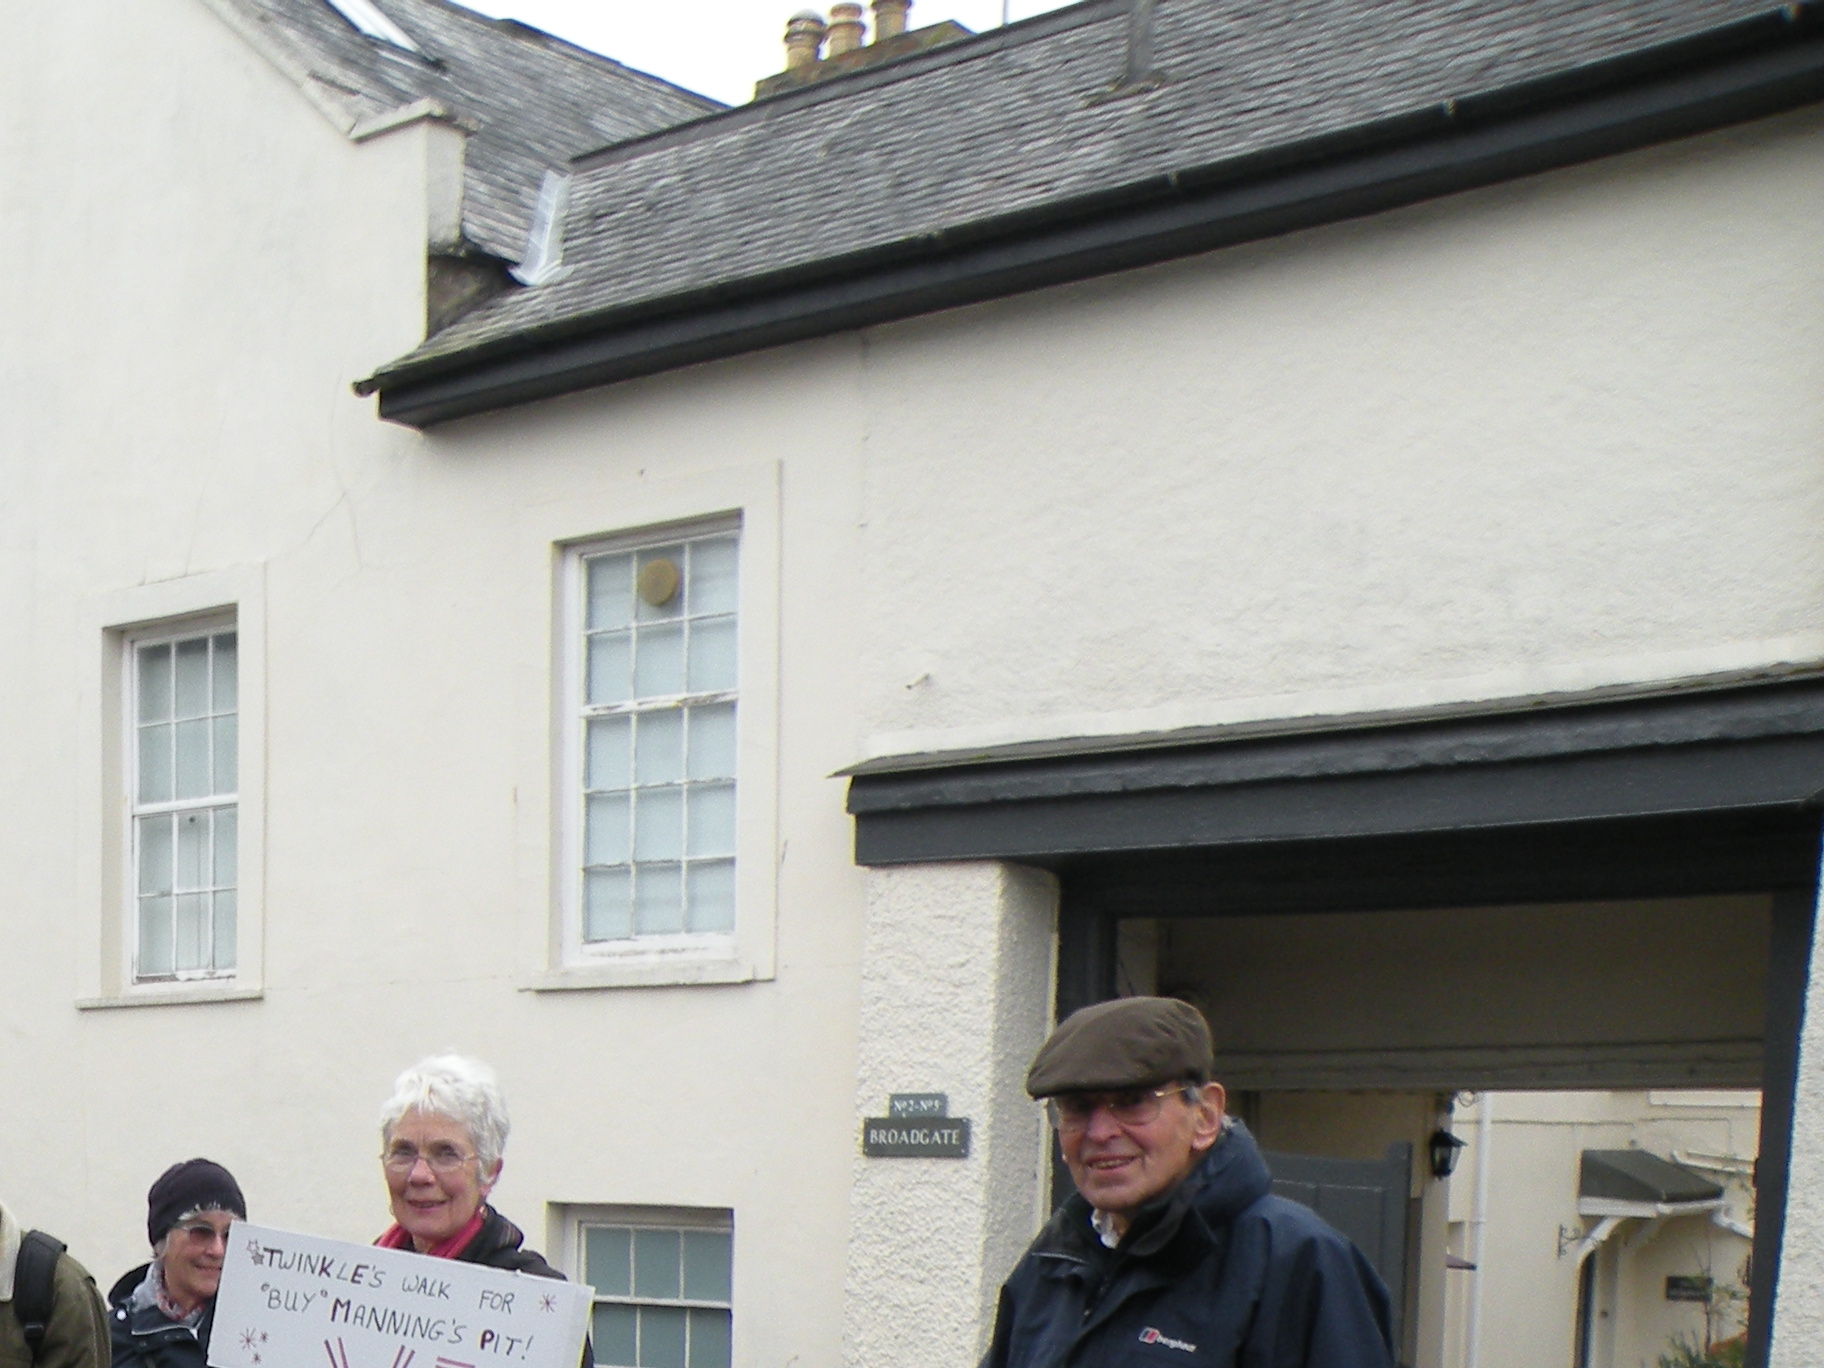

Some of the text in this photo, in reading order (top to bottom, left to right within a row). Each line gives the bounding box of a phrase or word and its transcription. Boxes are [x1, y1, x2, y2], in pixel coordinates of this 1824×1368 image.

[869, 1128, 961, 1145] BROADGATE
[262, 1247, 516, 1315] TWINKLE'S WALK FOR
[330, 1297, 468, 1345] MANNING'S
[479, 1328, 535, 1361] PIT!
